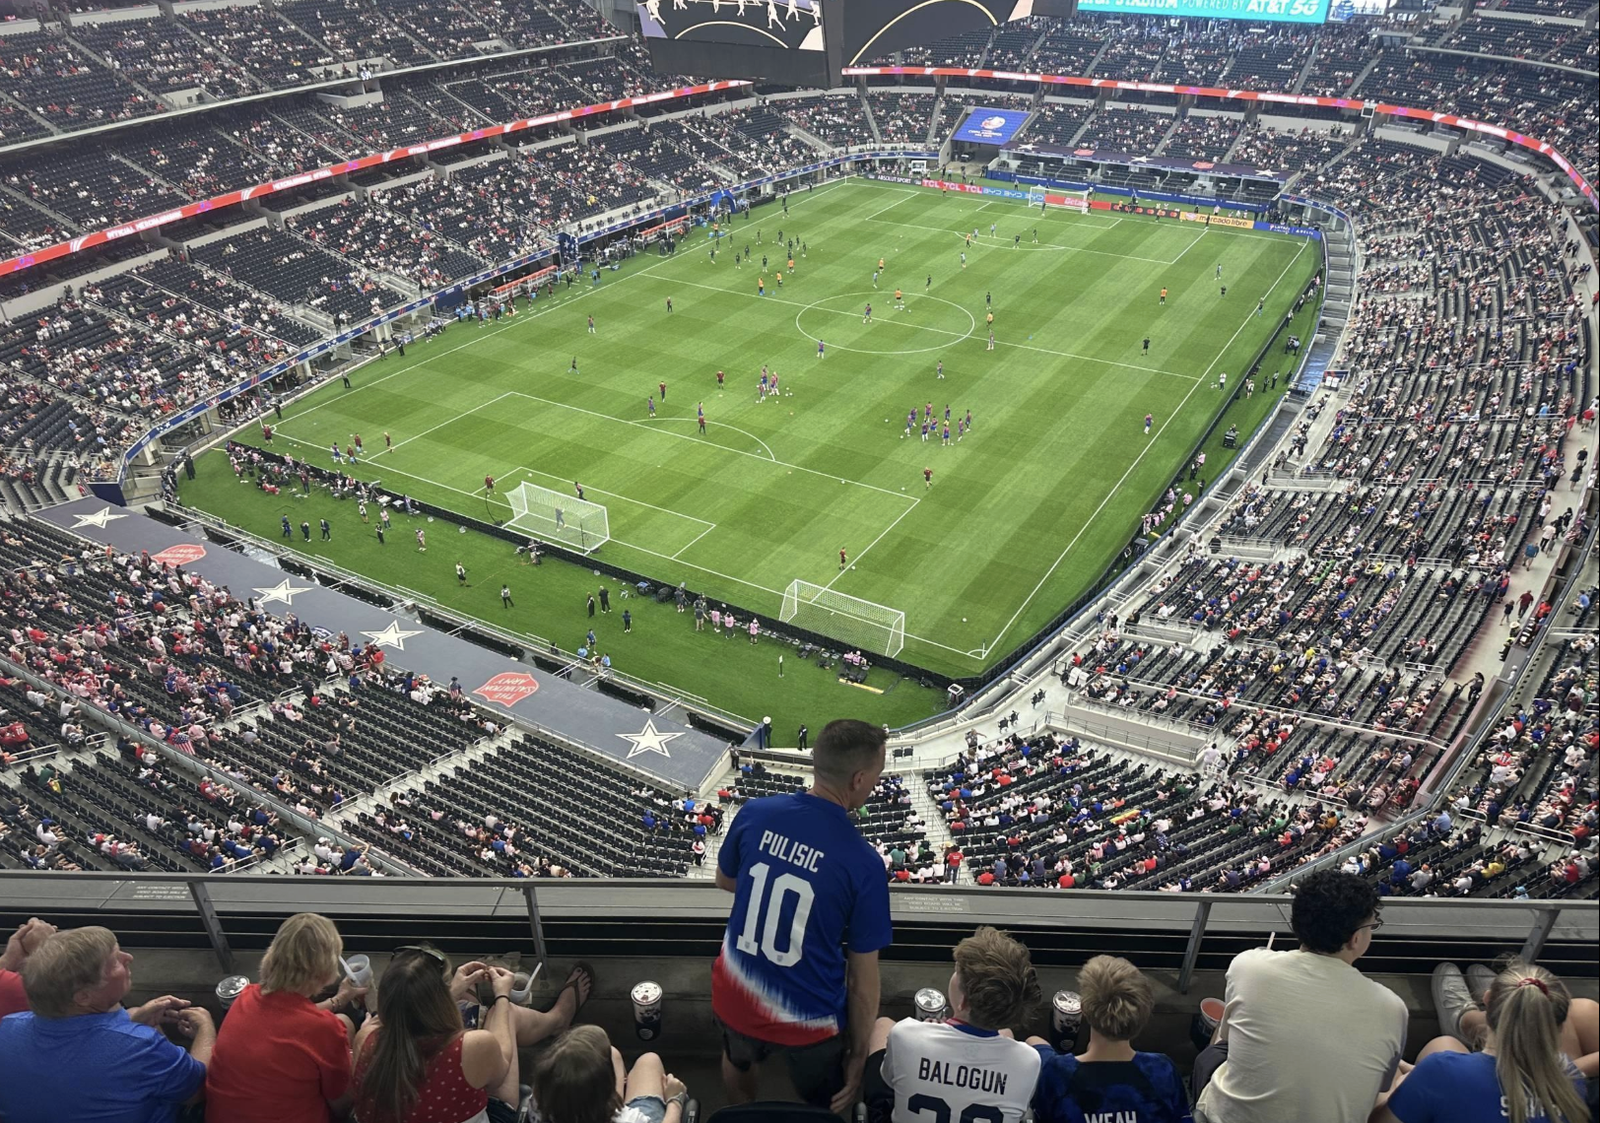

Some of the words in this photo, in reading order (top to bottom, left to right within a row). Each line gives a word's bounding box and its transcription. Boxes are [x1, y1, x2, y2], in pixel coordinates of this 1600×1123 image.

[1182, 0, 1228, 10] POWERED
[1232, 0, 1243, 11] BY
[1246, 0, 1288, 14] AT&T
[1289, 0, 1319, 16] 5G
[923, 180, 940, 188] TCL
[943, 182, 961, 191] TCL
[964, 184, 983, 194] TCL
[1004, 190, 1022, 198] BYD
[1199, 215, 1231, 225] mrcado
[1231, 219, 1248, 227] libre
[758, 829, 825, 873] PULISIC
[736, 861, 815, 967] 10
[918, 1057, 1008, 1096] BALOGUN
